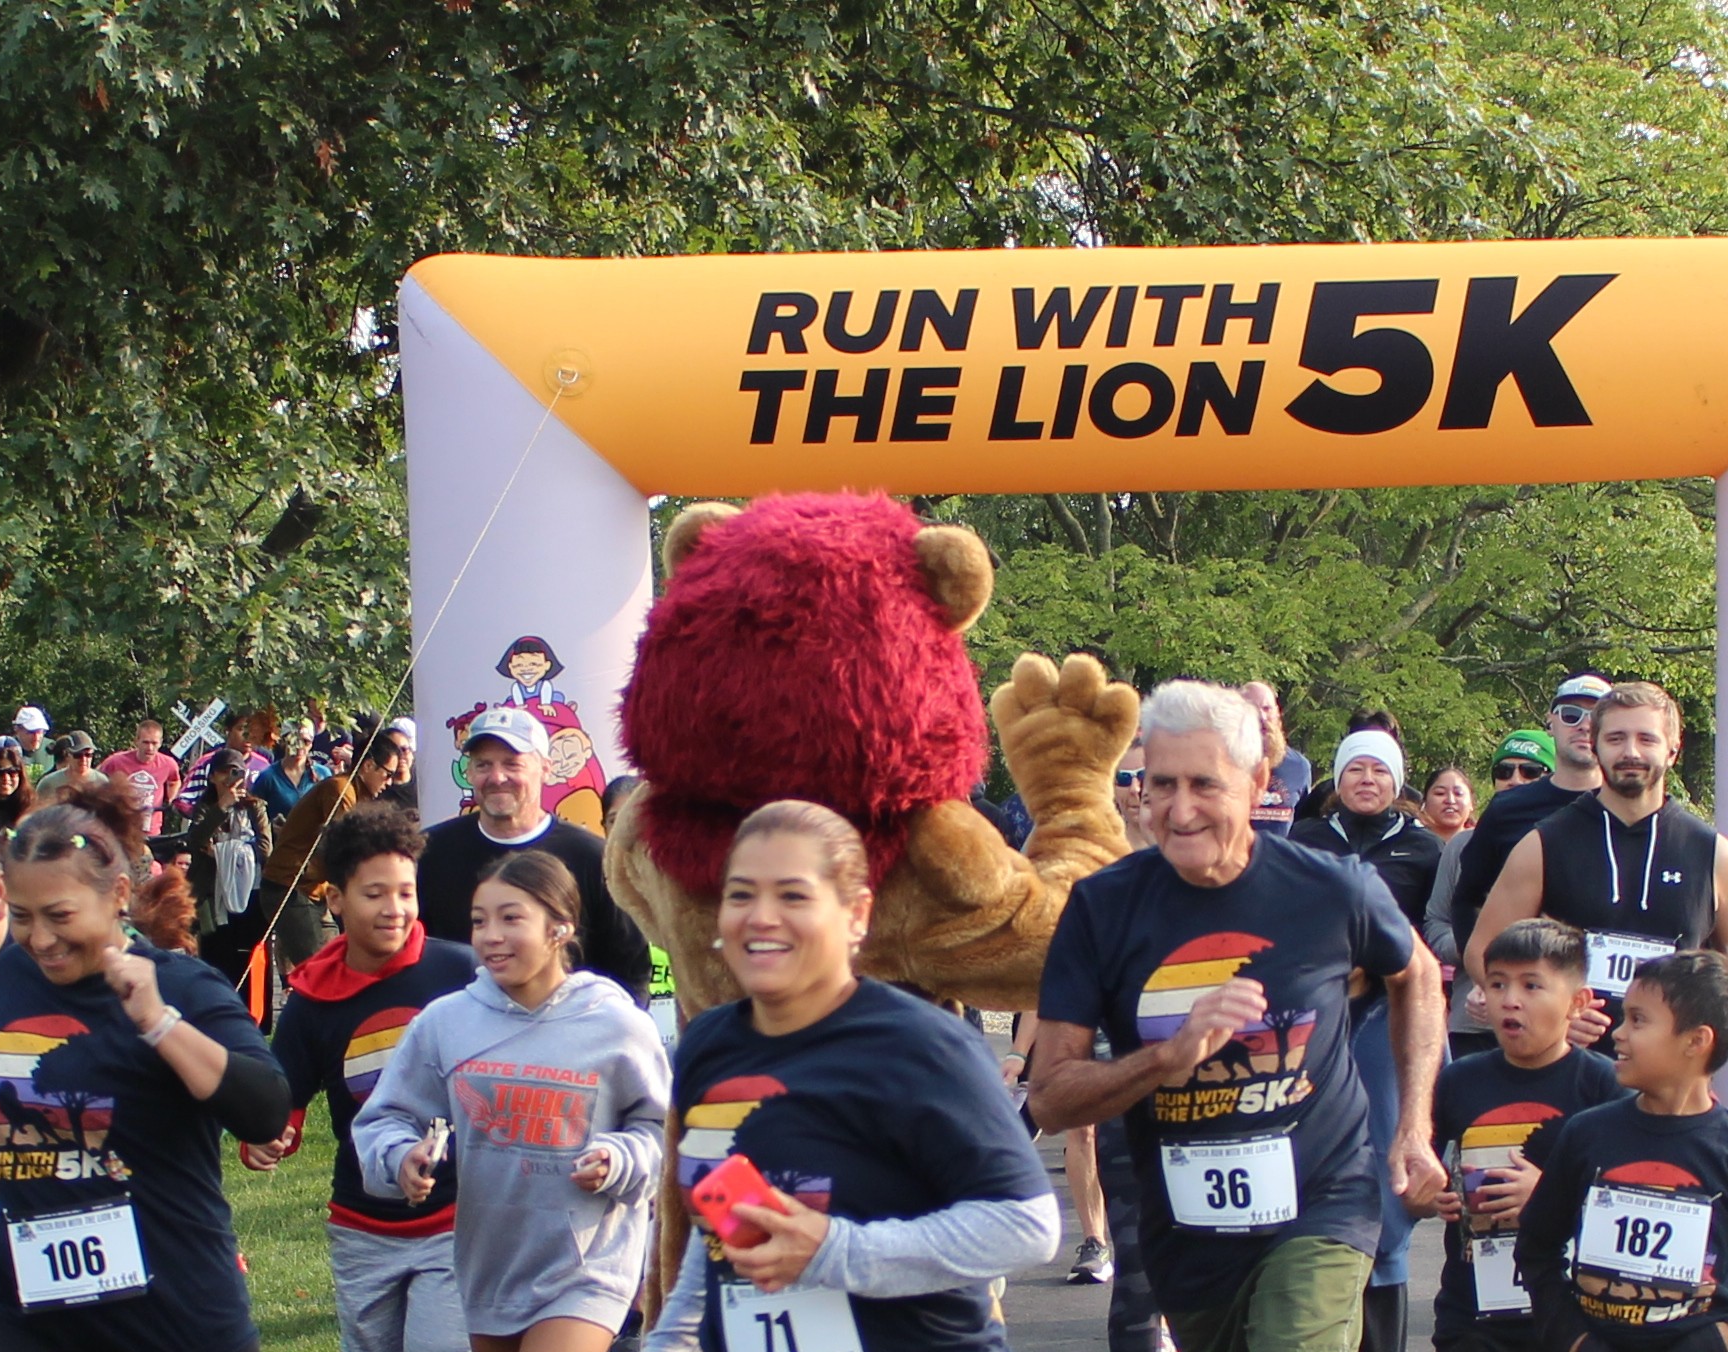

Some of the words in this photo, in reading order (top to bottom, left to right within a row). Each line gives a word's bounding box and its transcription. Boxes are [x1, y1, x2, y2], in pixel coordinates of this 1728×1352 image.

[746, 287, 980, 355] RUN
[1011, 281, 1281, 350] WITH
[1284, 273, 1621, 438] 5K
[738, 365, 963, 445] THE
[988, 360, 1265, 442] LION
[179, 707, 217, 749] CROSSING
[1606, 953, 1648, 981] 10
[454, 1059, 517, 1076] STATE
[523, 1064, 600, 1086] FINALS
[493, 1083, 589, 1118] TRACK
[1154, 1092, 1191, 1106] RUN
[1194, 1087, 1240, 1105] WITH
[1155, 1106, 1189, 1122] THE
[1191, 1102, 1235, 1121] LION
[1237, 1077, 1295, 1114] 5K
[16, 1151, 55, 1165] WITH
[54, 1150, 107, 1181] 5K
[1204, 1168, 1252, 1209] 36
[1614, 1215, 1673, 1261] 182
[42, 1235, 107, 1282] 106
[1580, 1295, 1604, 1311] RUN
[1606, 1302, 1646, 1319] WITH
